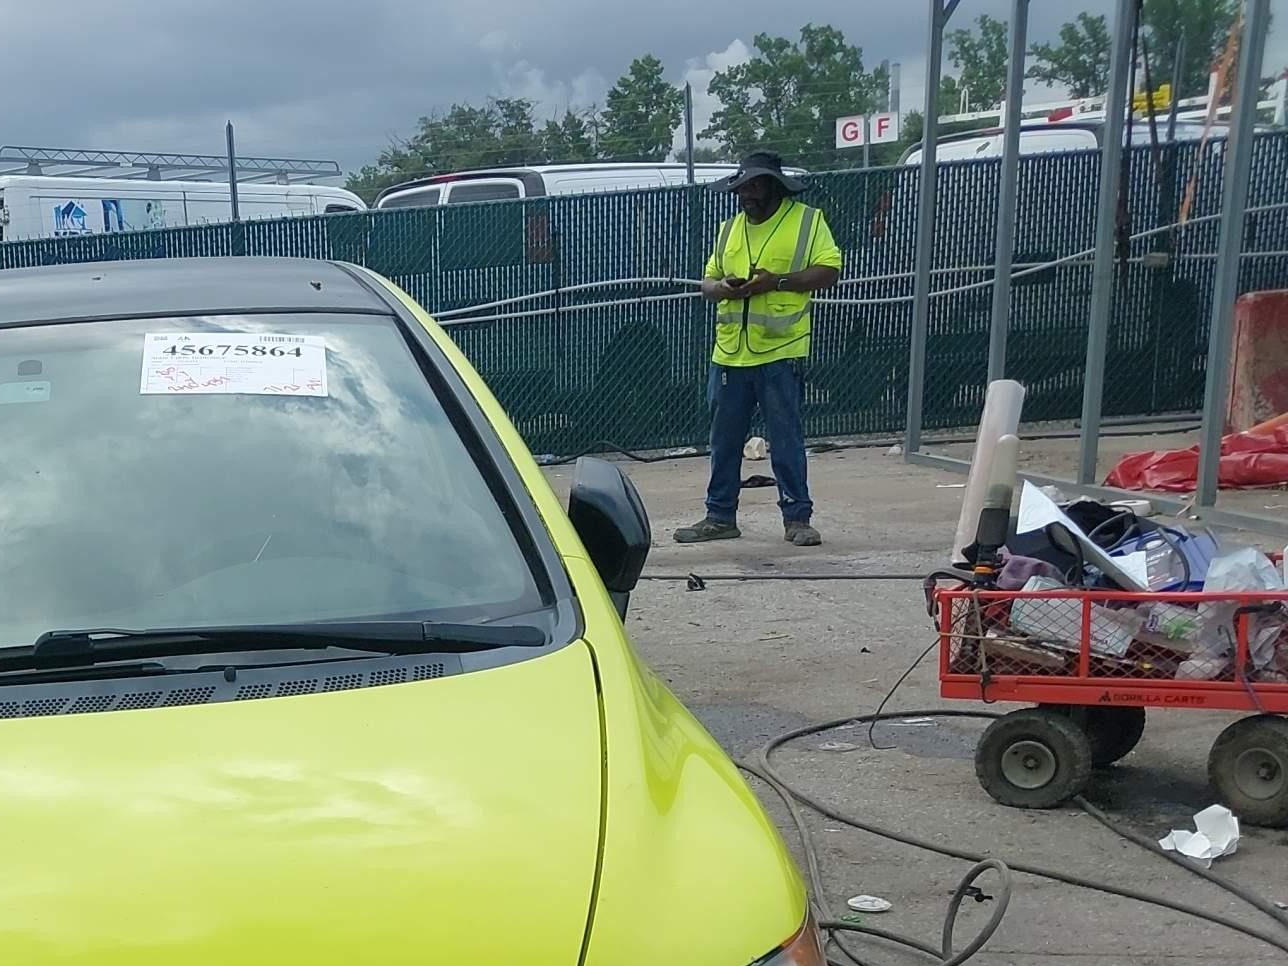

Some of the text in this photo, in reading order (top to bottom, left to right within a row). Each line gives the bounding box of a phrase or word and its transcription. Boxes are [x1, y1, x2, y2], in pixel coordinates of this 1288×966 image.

[841, 122, 859, 142] G
[877, 118, 890, 138] F
[163, 345, 303, 358] 45675864
[1113, 693, 1161, 703] GORILLA
